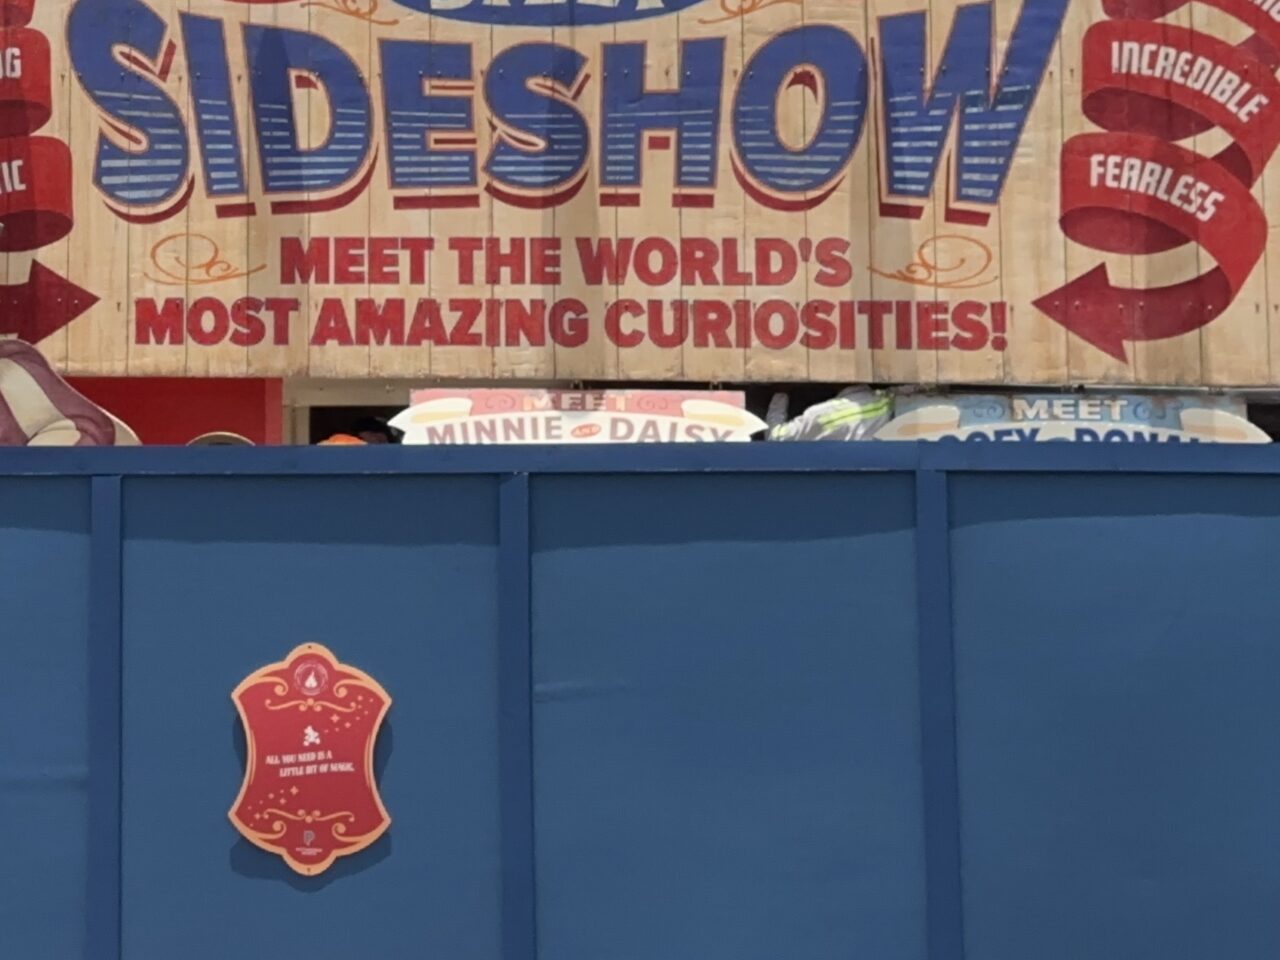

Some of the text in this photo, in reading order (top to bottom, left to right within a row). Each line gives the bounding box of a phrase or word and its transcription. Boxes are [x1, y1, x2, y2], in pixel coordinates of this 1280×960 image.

[1111, 41, 1269, 123] INCREDIBLE
[1090, 154, 1225, 222] FEARLESS
[280, 236, 852, 286] MEET THE WORLD'S
[135, 297, 1009, 351] MOST AMAZING CURIOSITIES!
[522, 393, 633, 411] MEET
[1014, 399, 1129, 421] MEET
[425, 415, 563, 445] MINNIE
